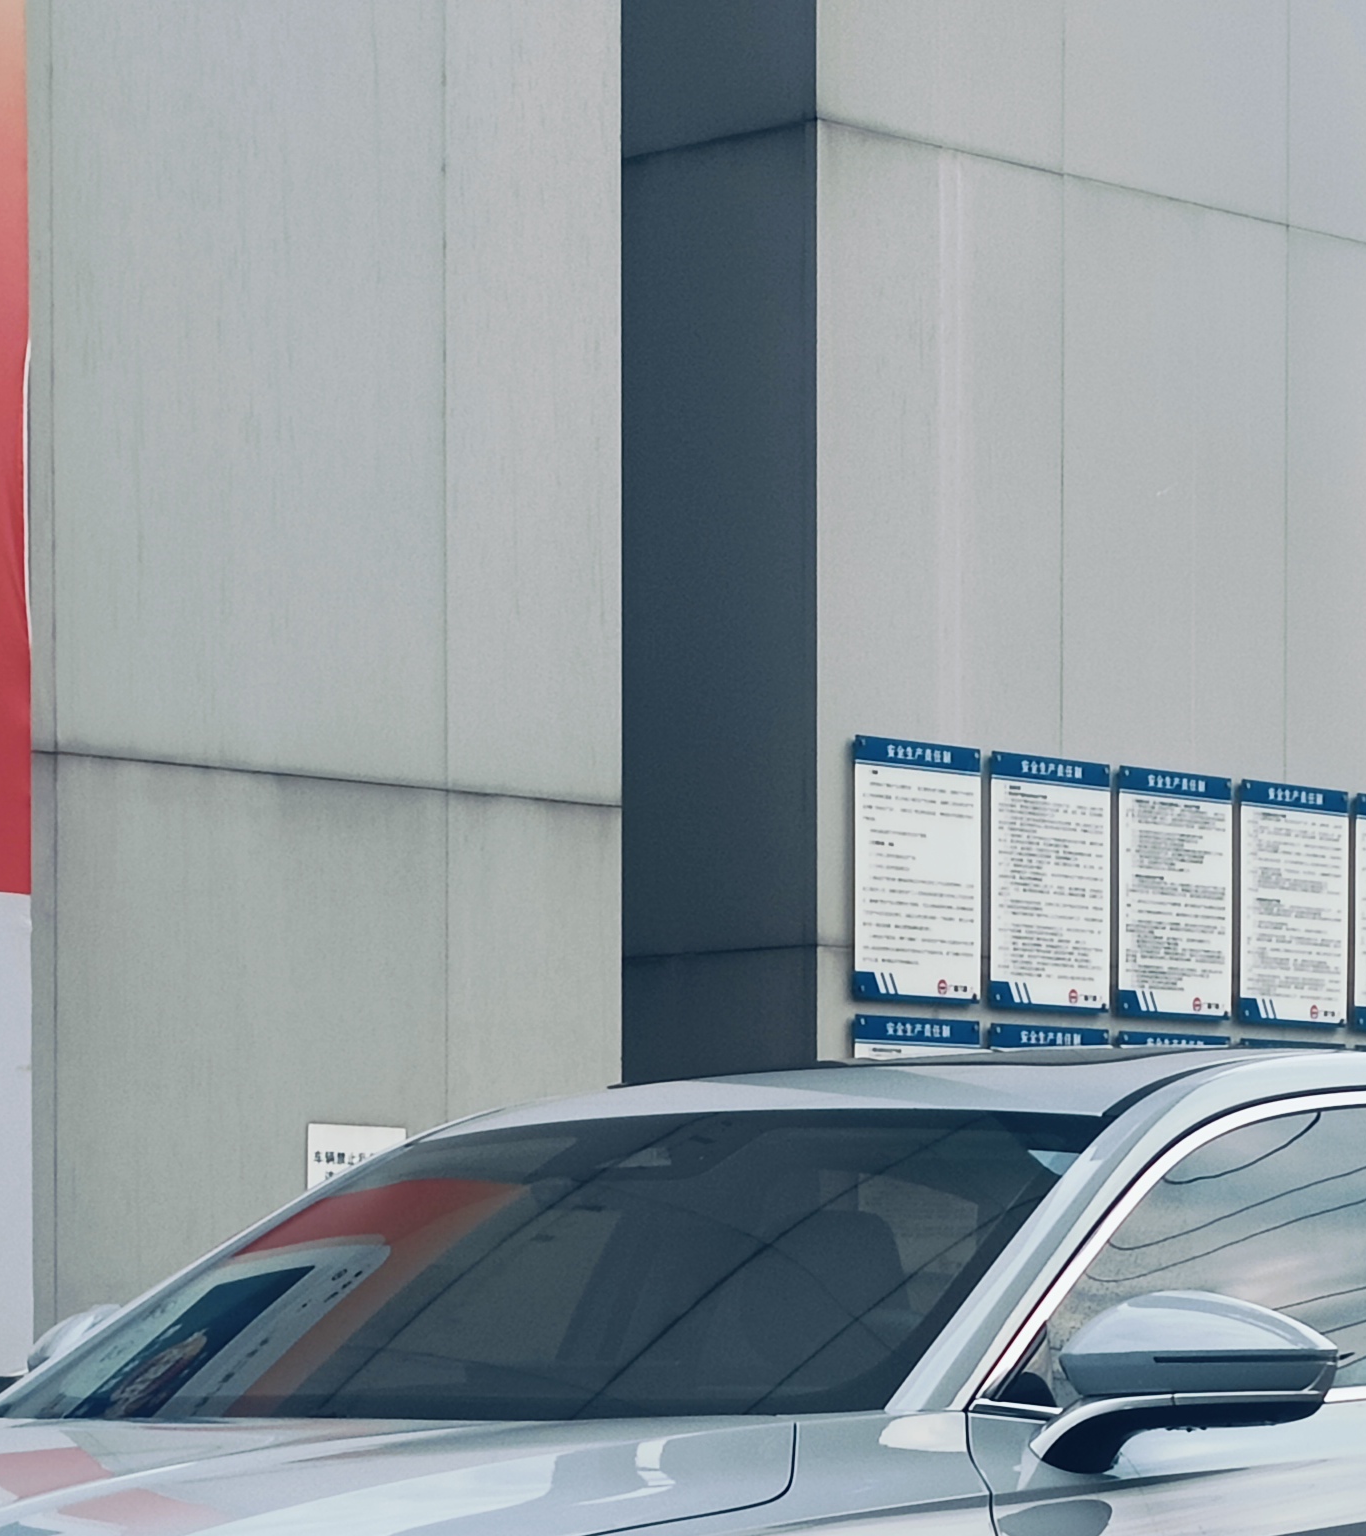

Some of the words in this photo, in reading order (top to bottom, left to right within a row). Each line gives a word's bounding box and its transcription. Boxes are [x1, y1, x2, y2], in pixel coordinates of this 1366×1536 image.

[887, 744, 952, 764] 安全生产责任制
[1021, 760, 1083, 779] 安全生产责任制
